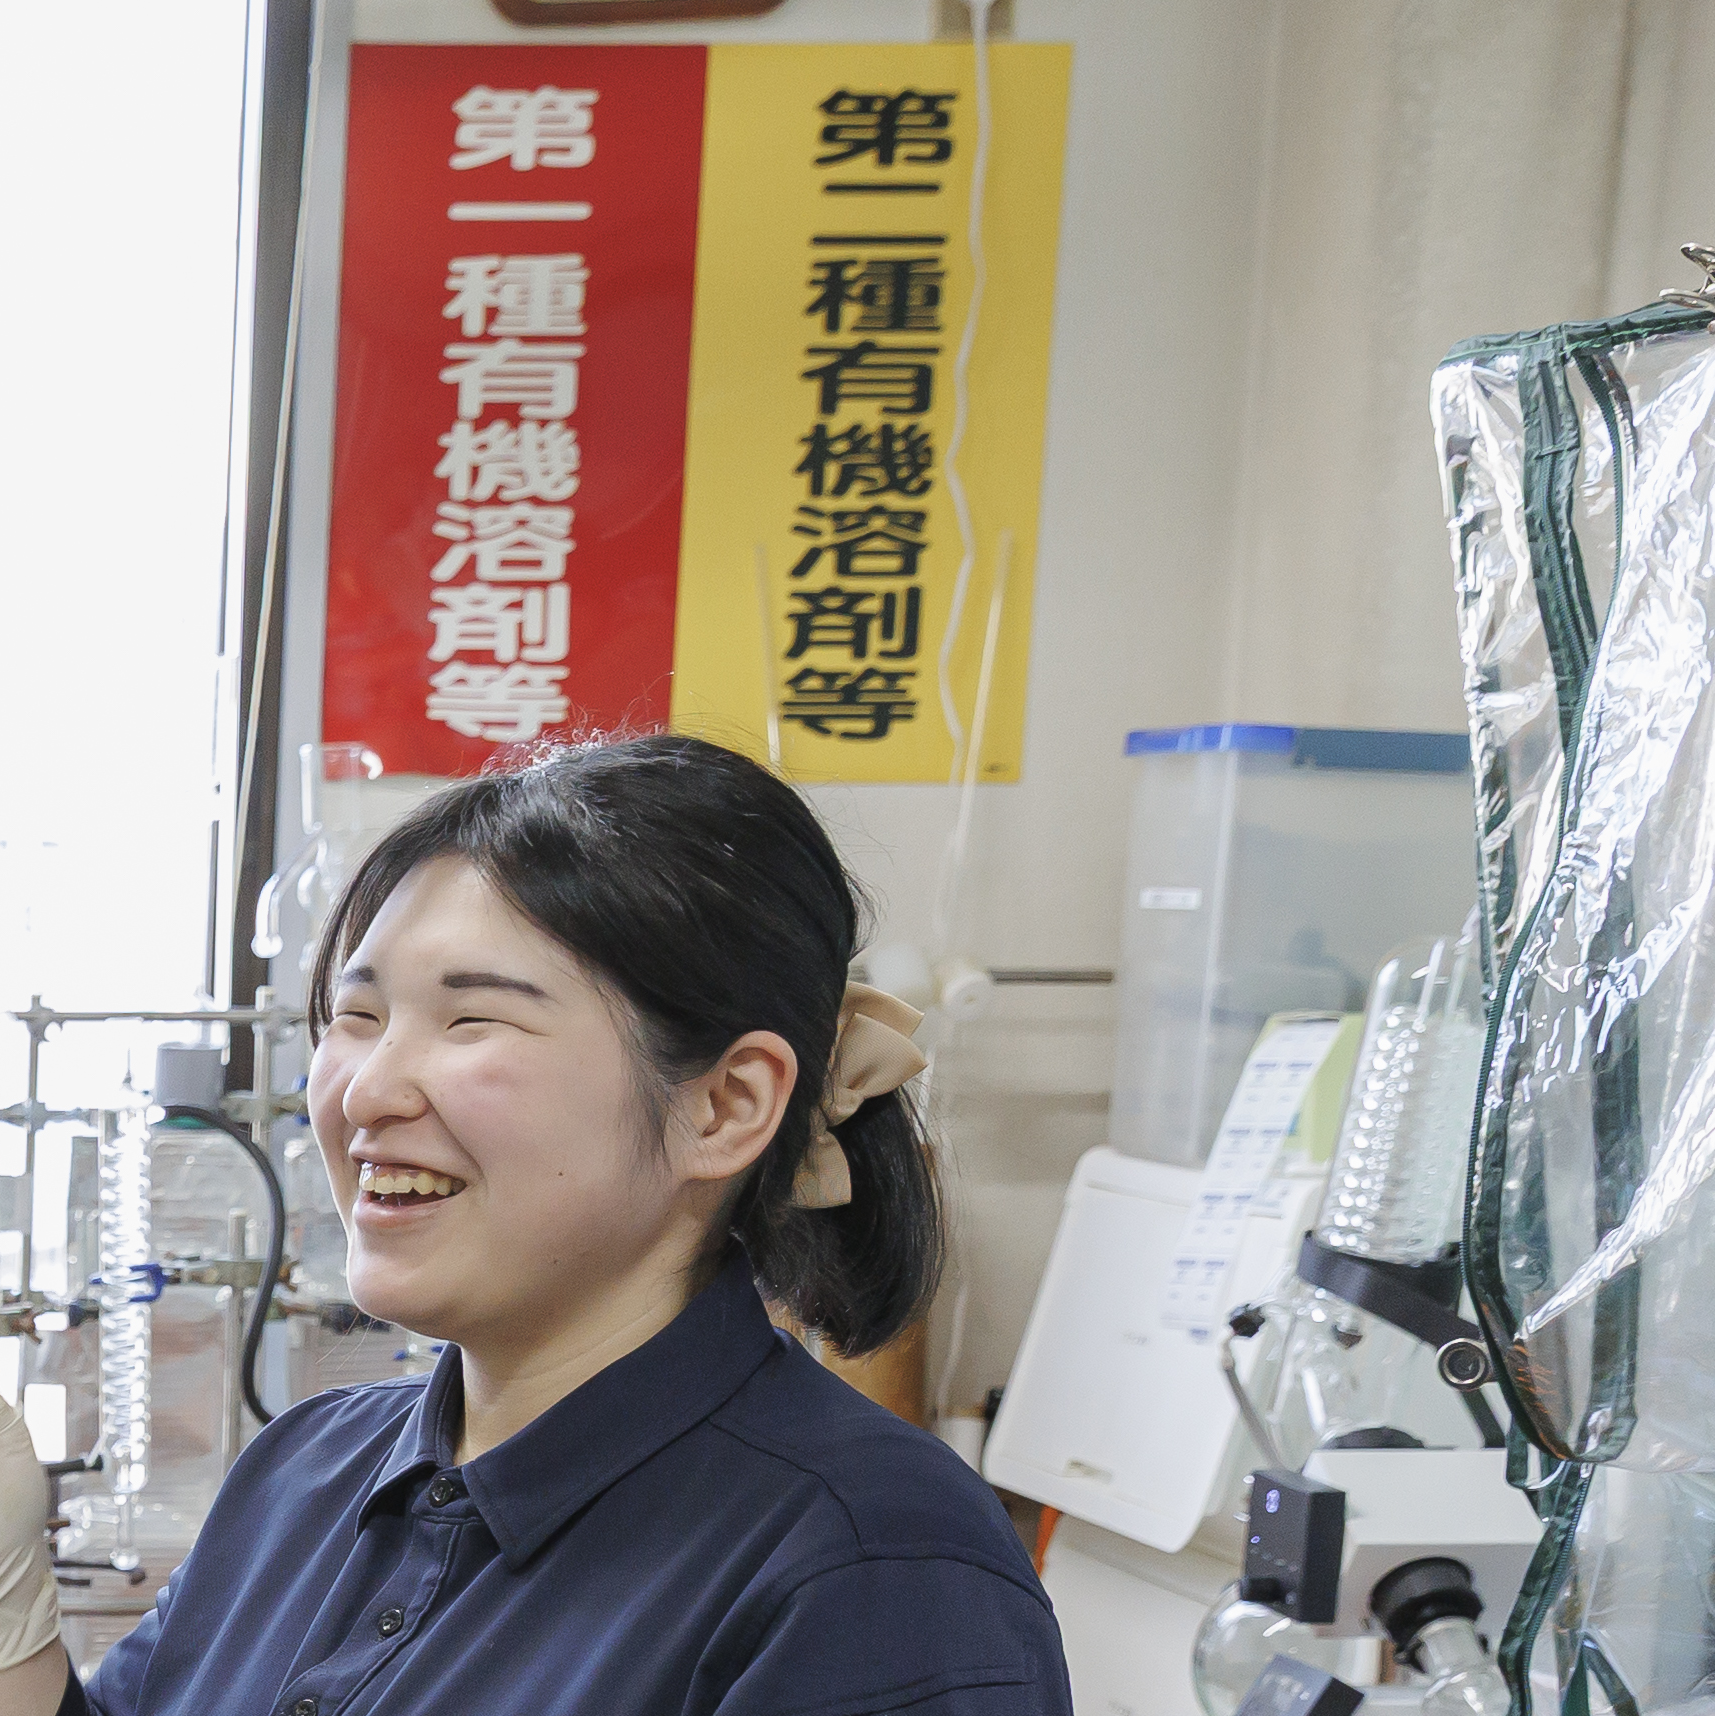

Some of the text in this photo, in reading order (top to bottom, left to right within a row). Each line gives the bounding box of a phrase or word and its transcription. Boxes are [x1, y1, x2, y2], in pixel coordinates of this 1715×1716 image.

[426, 85, 600, 745] 第一種有機溶剤等
[780, 87, 960, 742] 第二種有機溶剤等
